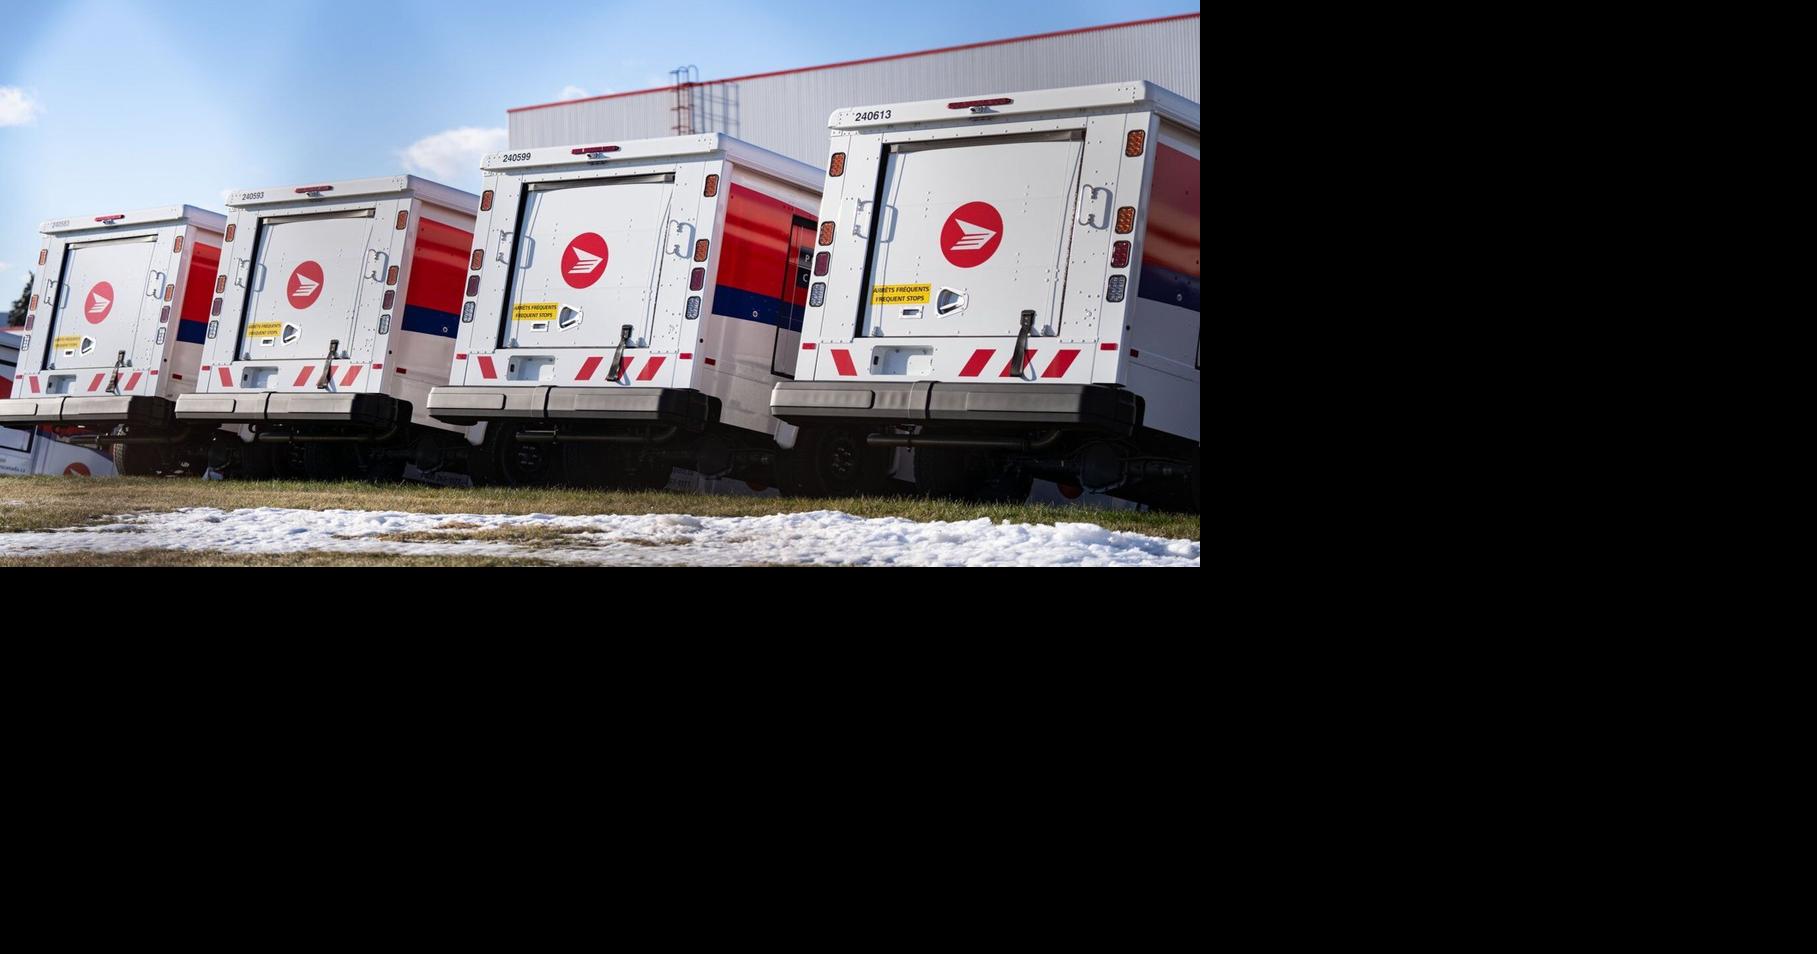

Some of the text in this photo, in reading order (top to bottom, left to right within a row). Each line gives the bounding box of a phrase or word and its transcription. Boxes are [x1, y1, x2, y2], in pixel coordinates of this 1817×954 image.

[855, 109, 892, 122] 240613
[502, 152, 532, 163] 240599
[241, 191, 265, 201] 240593
[896, 285, 930, 293] FRÉQUENTS
